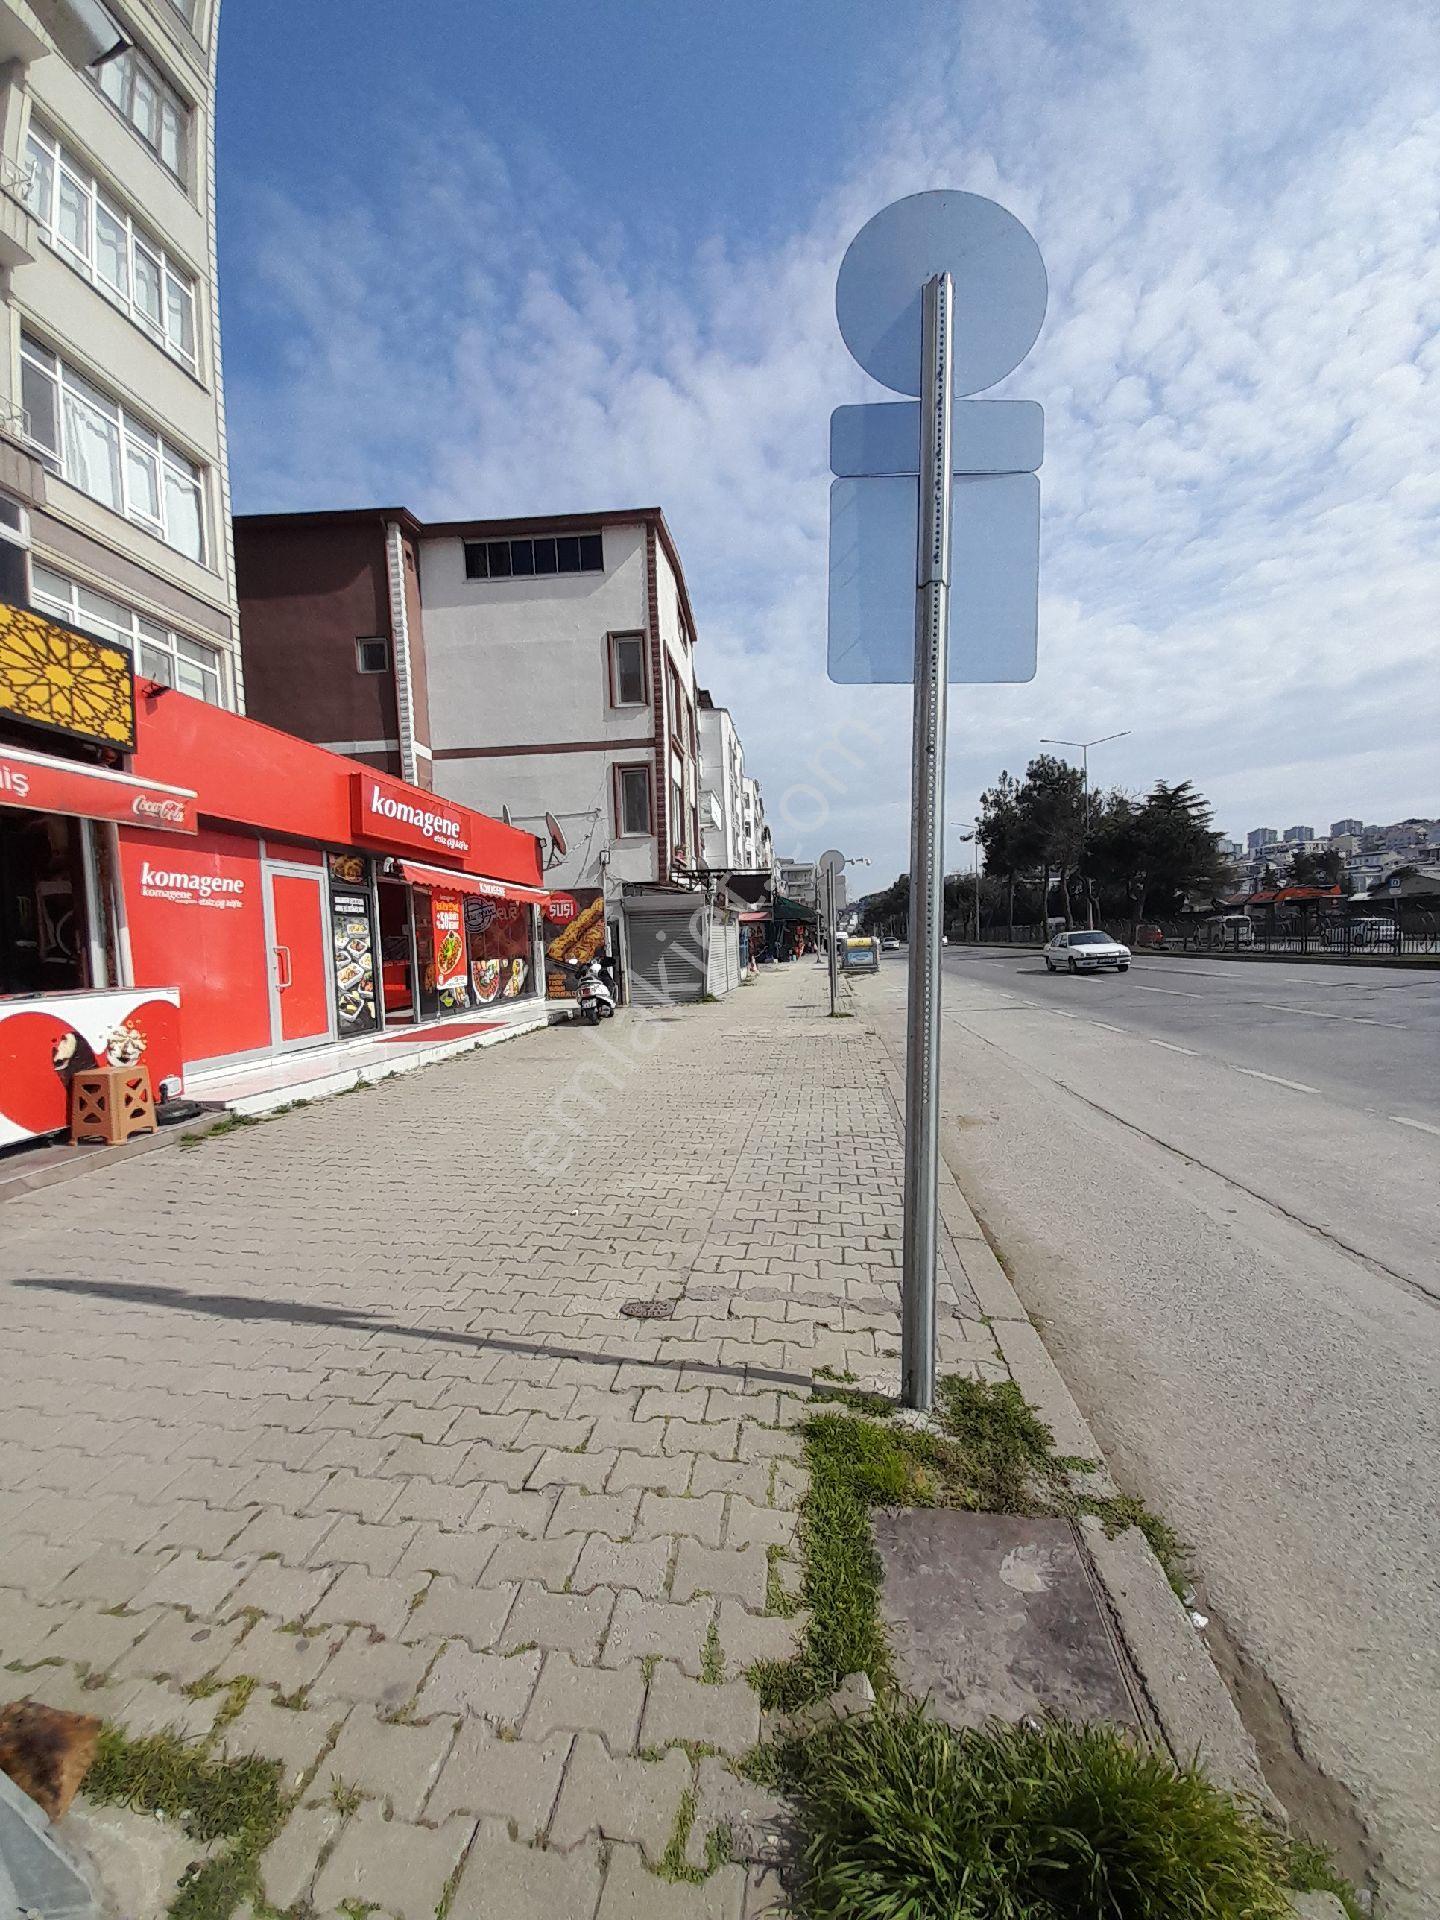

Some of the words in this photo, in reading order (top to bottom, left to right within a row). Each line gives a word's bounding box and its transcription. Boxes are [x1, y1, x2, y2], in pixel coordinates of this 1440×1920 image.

[0, 766, 30, 798] iş
[132, 795, 185, 823] Coca-Cola
[371, 785, 461, 837] komagene
[141, 861, 245, 897] komagene
[142, 886, 193, 901] komagene
